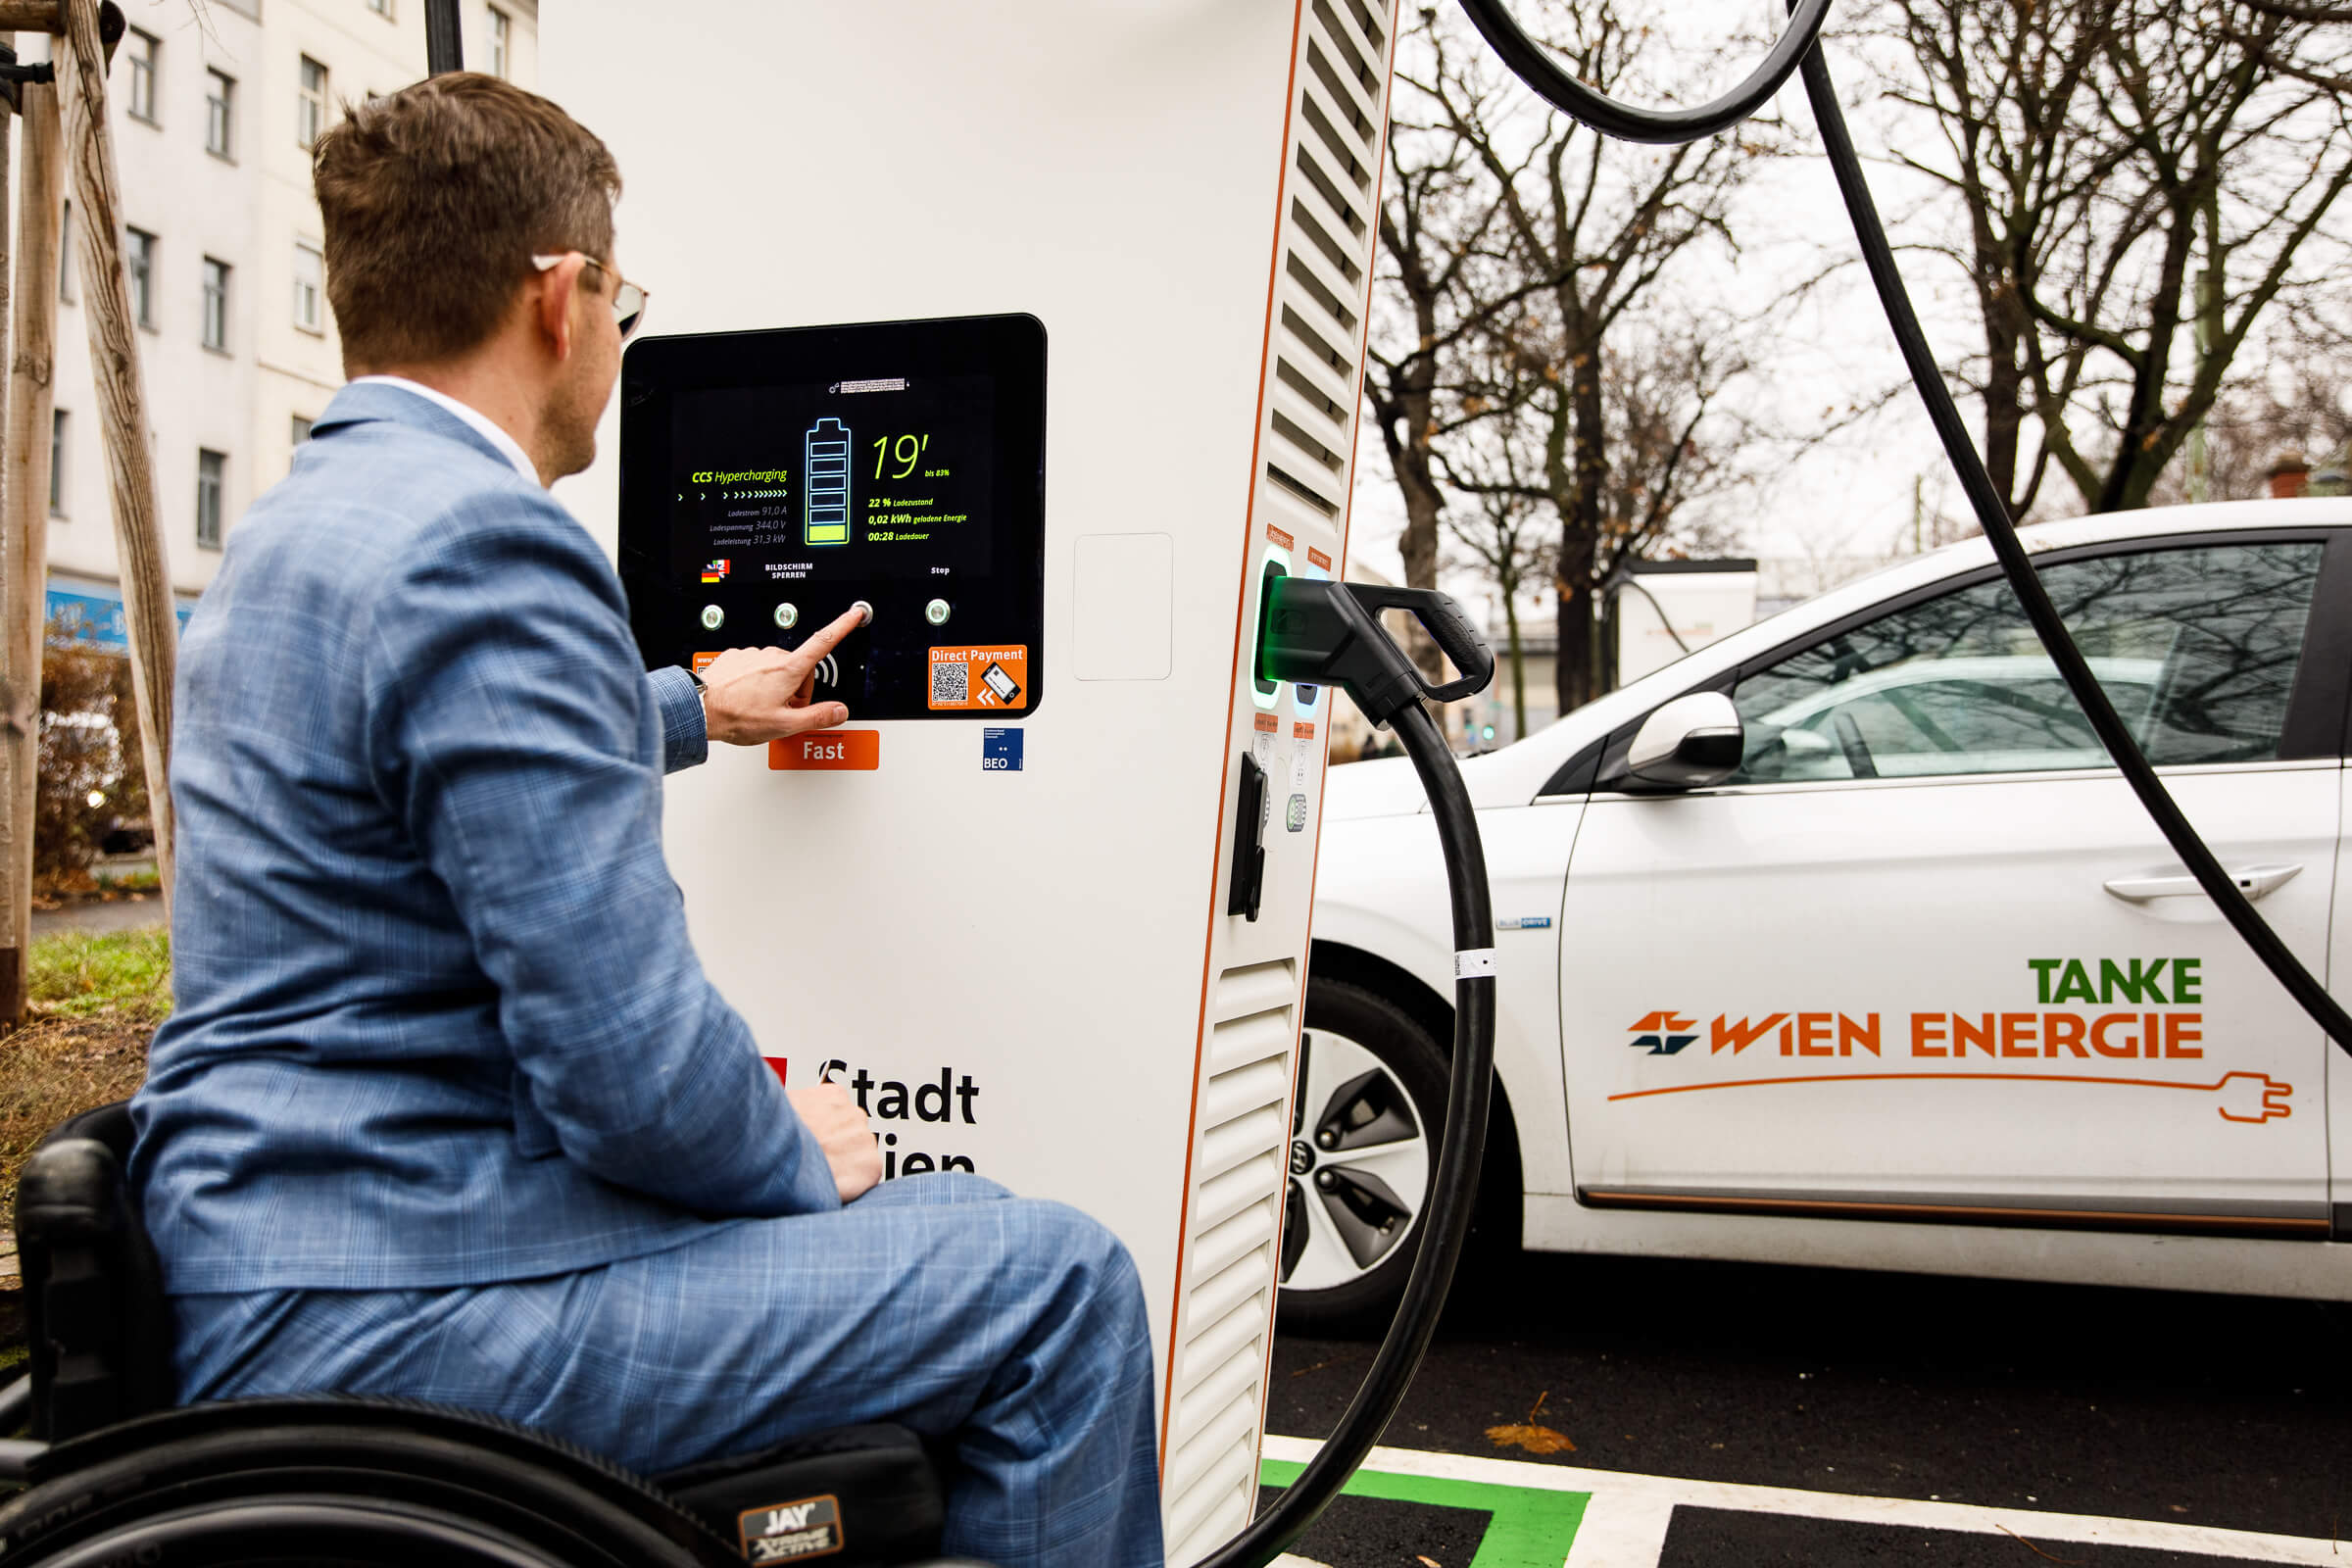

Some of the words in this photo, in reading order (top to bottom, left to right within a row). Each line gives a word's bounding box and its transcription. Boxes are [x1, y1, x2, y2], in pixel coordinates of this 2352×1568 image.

[692, 471, 713, 483] CCS
[714, 468, 788, 485] Hypercharging
[868, 498, 881, 508] 22
[893, 498, 934, 507] Ladezustand
[868, 514, 889, 525] 0,02
[890, 513, 912, 524] kWh
[912, 514, 943, 524] geladene
[943, 514, 968, 523] Energie
[867, 531, 894, 542] 00:28
[895, 532, 930, 541] Ladedauer
[764, 563, 813, 571] BILDSCHIRM
[930, 566, 951, 576] Stop
[932, 650, 967, 662] Direct
[970, 649, 1023, 663] Payment
[804, 741, 845, 760] Fast
[984, 758, 1007, 769] BEO
[2028, 957, 2202, 1004] TANKE
[1710, 1012, 1882, 1057] WIEN
[1911, 1012, 2203, 1059] ENERGIE
[872, 1132, 976, 1181] ien
[764, 1502, 815, 1536] JAY
